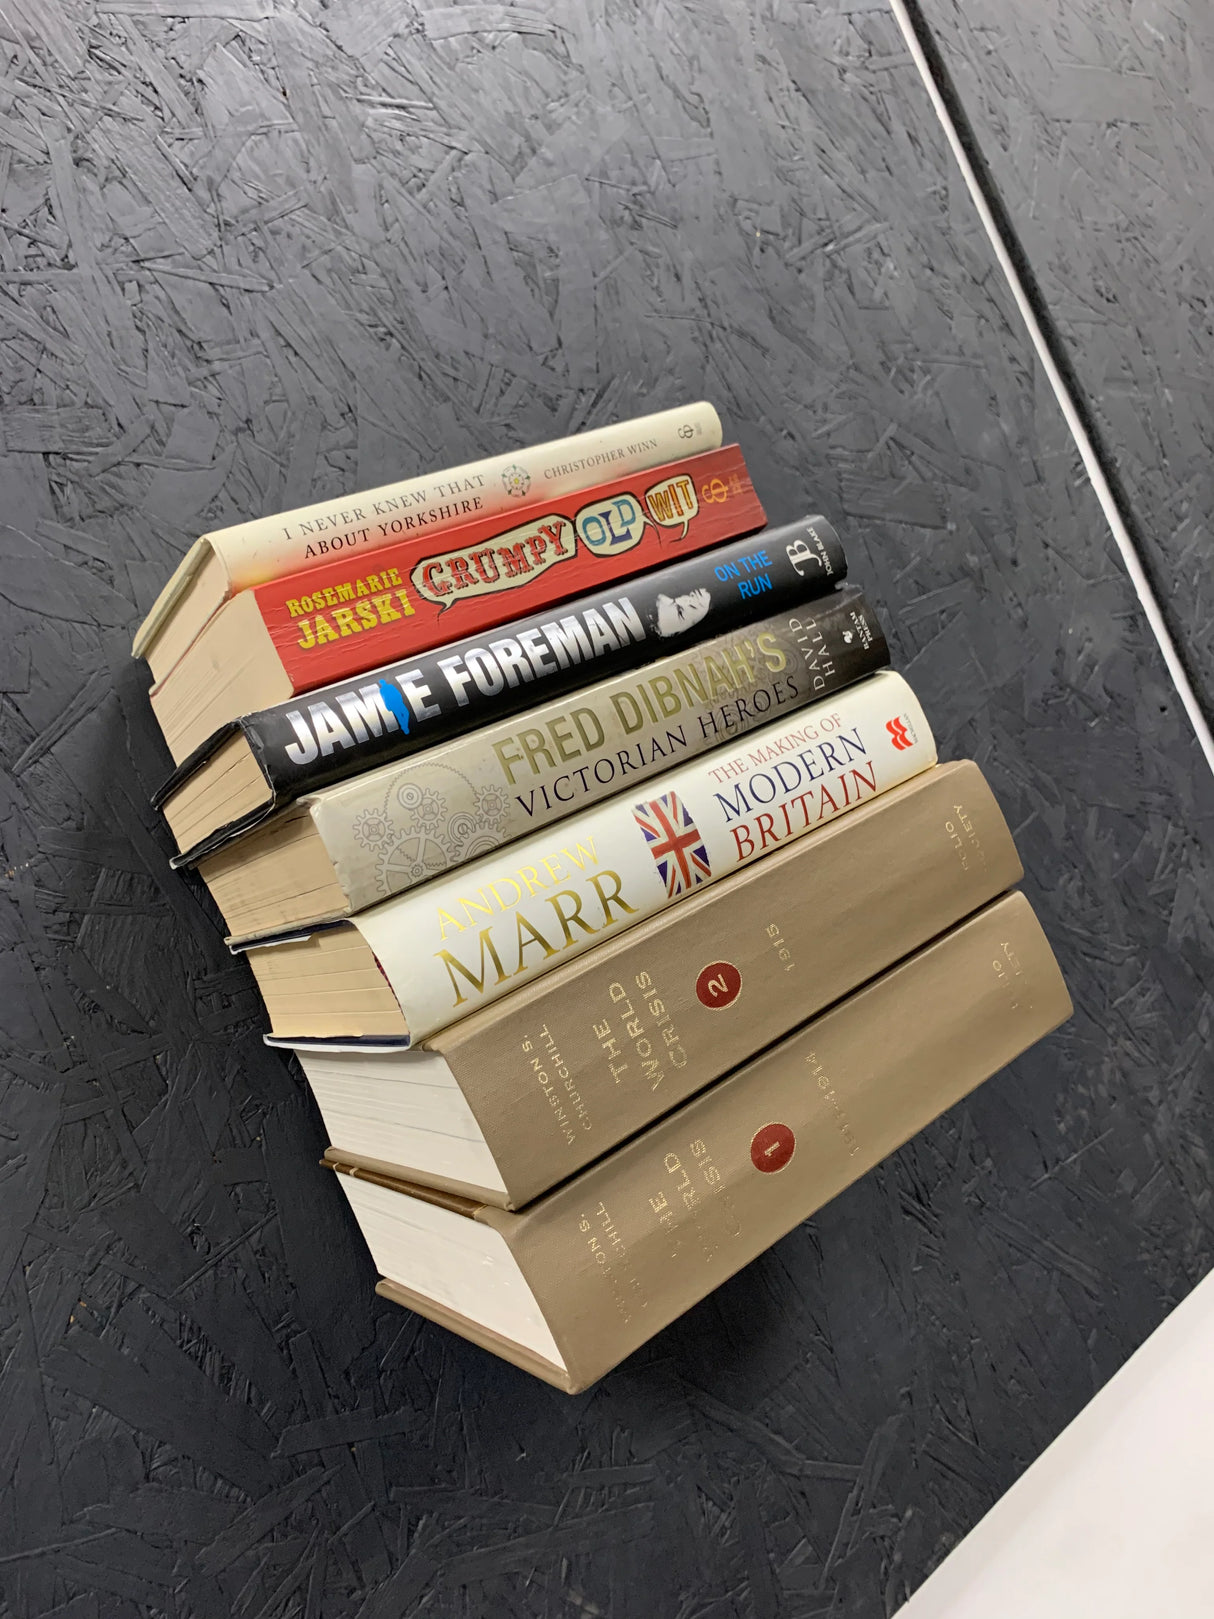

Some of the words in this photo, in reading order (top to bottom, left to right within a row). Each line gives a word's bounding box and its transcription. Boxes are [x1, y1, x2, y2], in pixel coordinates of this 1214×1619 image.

[544, 449, 625, 479] CHRISTOPHER
[626, 438, 658, 457] WINN
[283, 527, 292, 540] I
[298, 508, 367, 535] NEVER
[373, 489, 430, 515] KNEW
[434, 474, 486, 498] THAT
[304, 527, 371, 559] ABOUT
[377, 496, 484, 536] YORKSHIRE
[422, 520, 568, 596] GRUMPY
[582, 499, 636, 546] OLD
[647, 478, 694, 523] WIT
[285, 568, 402, 617] ROSEMARIE
[714, 562, 741, 582] ON
[738, 550, 773, 567] THE
[738, 573, 774, 600] RUN
[820, 551, 834, 576] JOHN
[297, 589, 416, 649] JARSKI
[437, 597, 647, 707] FOREMAN
[789, 618, 826, 691] DAVID
[806, 617, 836, 677] HALL
[492, 707, 605, 786] FRED
[609, 632, 787, 735] DIBNAH'S
[515, 725, 688, 817] VICTORIAN
[697, 675, 799, 739] HEROES
[708, 758, 749, 784] THE
[749, 725, 819, 766] MAKING
[820, 713, 842, 733] OF
[713, 727, 867, 823] MODERN
[730, 760, 877, 862] BRITAIN
[436, 836, 599, 941] ANDREW
[433, 870, 640, 1008] MARR
[635, 971, 688, 1069] CRISIS
[708, 973, 730, 998] 2
[592, 1018, 628, 1084] THE
[608, 982, 665, 1092] WORLD
[530, 1057, 576, 1145] WINSTON
[539, 1023, 592, 1130] CHURCHILL
[765, 1141, 780, 1157] 1
